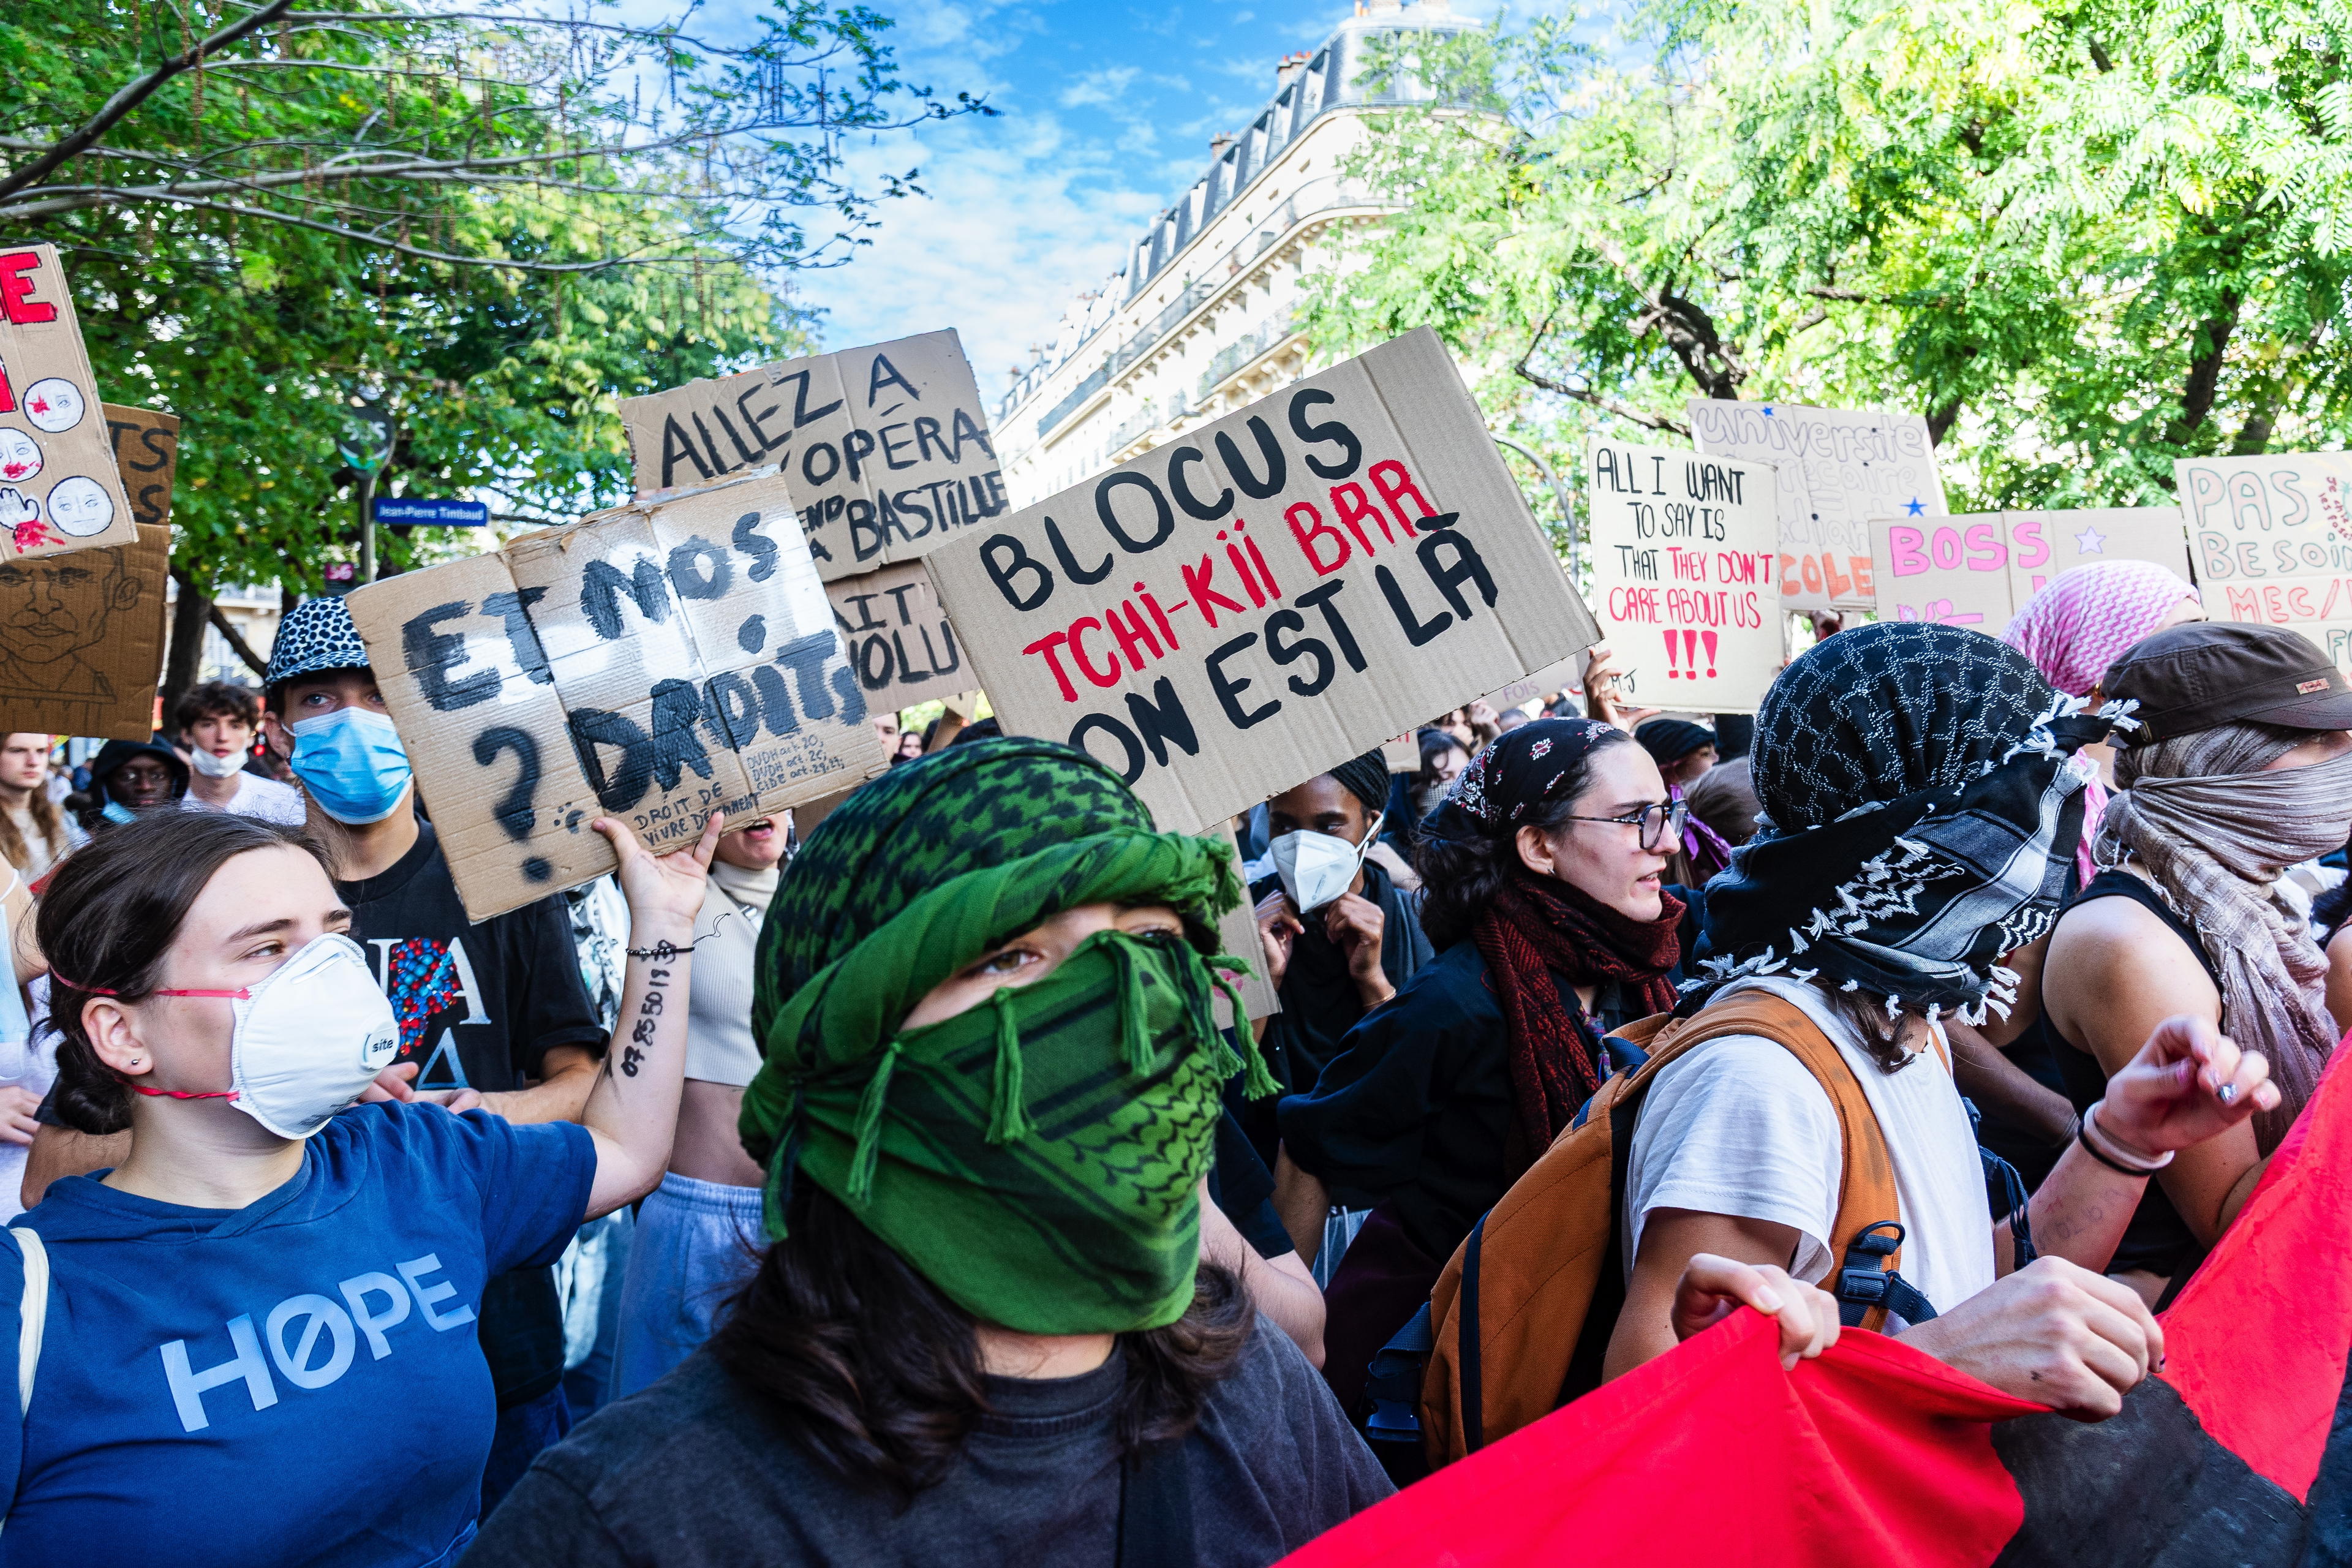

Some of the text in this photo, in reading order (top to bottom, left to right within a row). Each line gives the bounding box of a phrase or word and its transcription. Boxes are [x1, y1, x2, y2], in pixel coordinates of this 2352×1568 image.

[662, 369, 843, 488] ALLEZ
[980, 388, 1362, 611] BLOCUS
[1597, 448, 1745, 505] ALL I WANT
[2189, 467, 2309, 530] PAS
[1284, 458, 1439, 578] BRR
[1627, 502, 1725, 541] TO SAY IS
[1613, 545, 1774, 585] THAT THEY DON'T
[1888, 521, 2051, 578] BOSS
[402, 511, 780, 712] ET NOS
[1609, 586, 1762, 629] CARE ABOUT US
[1068, 675, 1200, 788] ON
[1204, 578, 1369, 731] EST
[634, 781, 723, 831] DROIT DE
